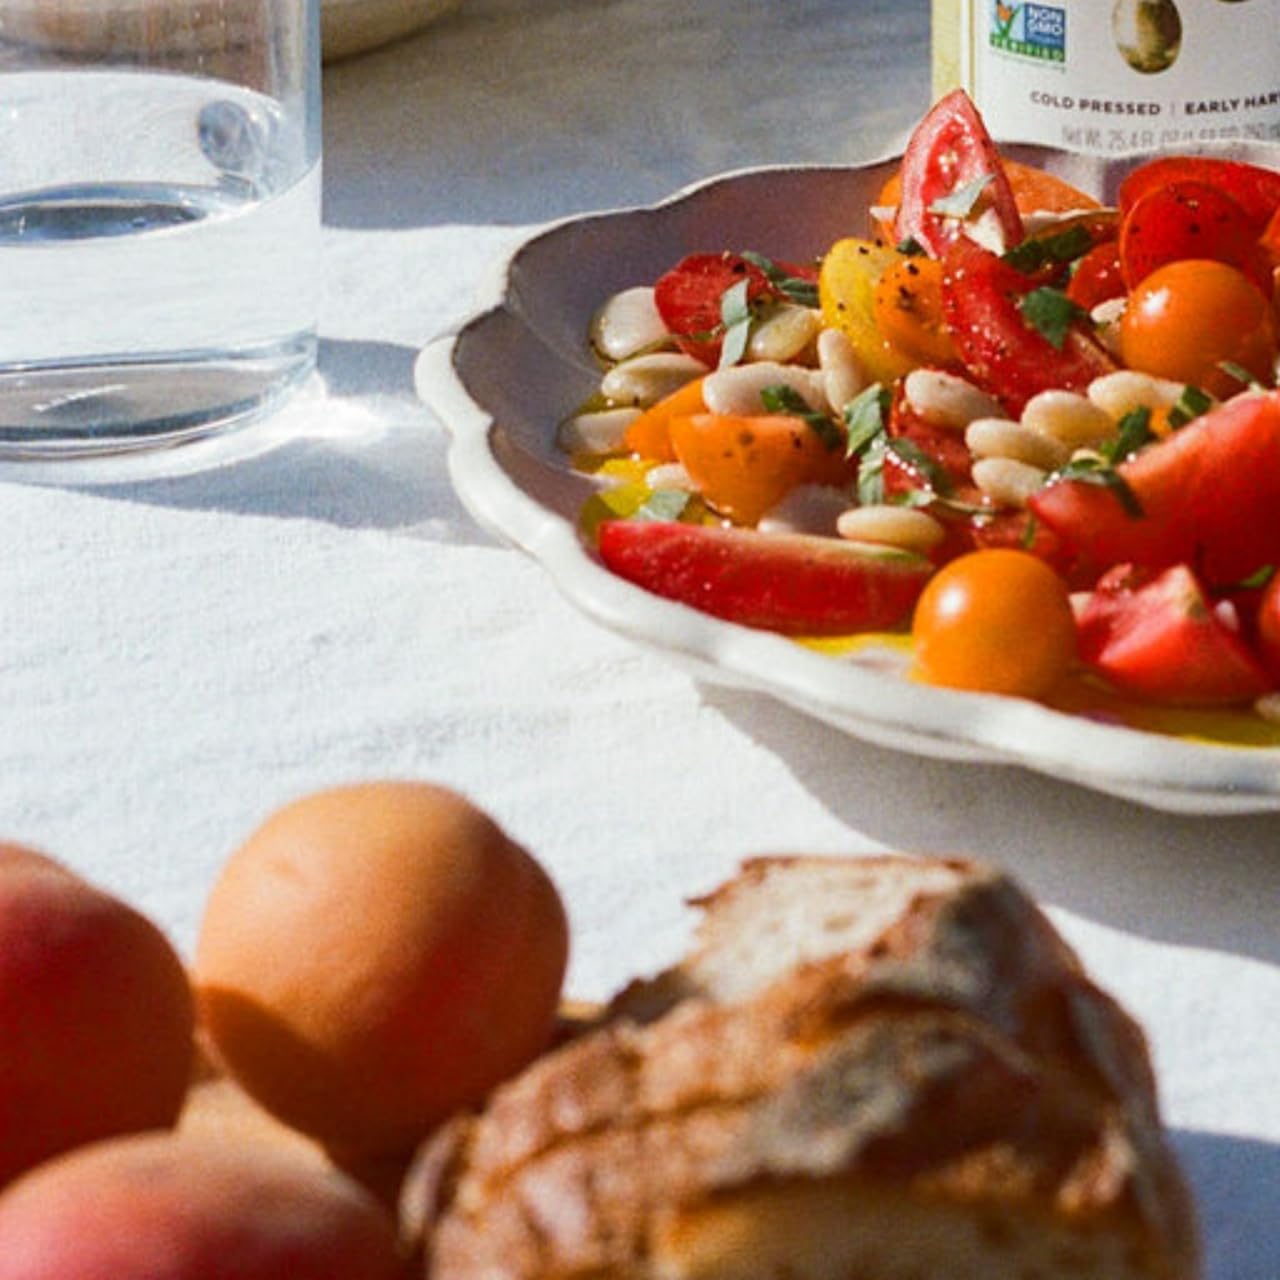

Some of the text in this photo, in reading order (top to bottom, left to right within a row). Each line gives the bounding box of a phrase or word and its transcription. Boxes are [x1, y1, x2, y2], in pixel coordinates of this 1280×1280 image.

[1030, 90, 1075, 109] COLD
[1078, 98, 1161, 116] PRESSED
[1185, 97, 1240, 116] EARLY
